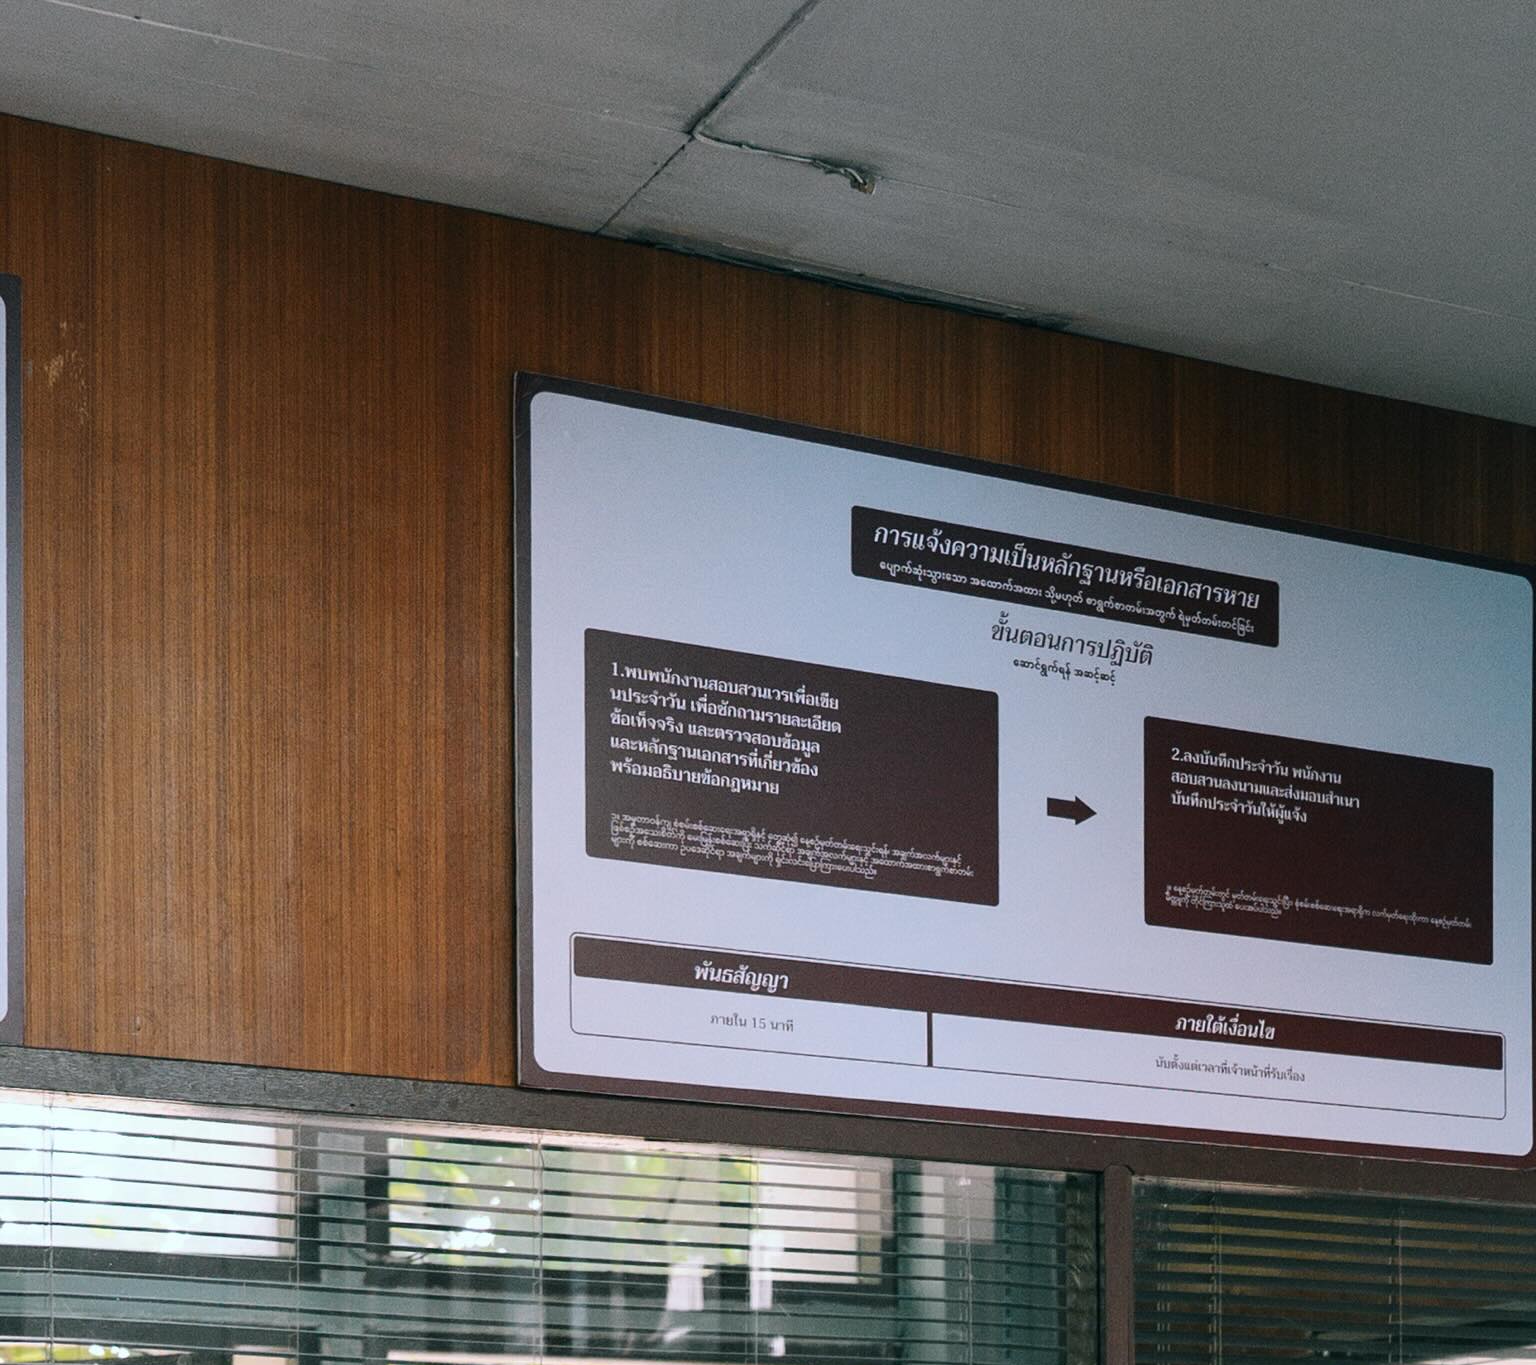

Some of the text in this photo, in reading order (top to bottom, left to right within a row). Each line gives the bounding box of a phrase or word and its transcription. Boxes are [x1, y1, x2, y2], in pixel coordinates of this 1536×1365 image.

[873, 525, 1260, 610] การแจ้งความเป็นหลักฐานหรือเอกสารหาย
[970, 577, 1042, 597] အထောက်အထား
[1044, 585, 1084, 607] သို့မဟုတ်
[991, 610, 1154, 667] ขั้นตอนการปฏิบัติ
[610, 661, 839, 710] 1.พบพนักงานสอบสวนเวรเพื่อเขีย
[610, 687, 842, 734] นประจำวัน เพื่อซักถามรายละเอียด
[610, 710, 821, 758] ข้อเท็จจริง และตรวจสอบข้อมูล
[610, 735, 818, 777] และหลักฐานเอกสารที่เกี่ยวข้อง
[1171, 747, 1342, 785] 2.ลงบันทึกประจำวัน พนักงาน
[610, 757, 780, 795] พร้อมอธิบายข้อกฎหมาย
[1171, 770, 1360, 808] สอบสวนลงนามและส่งมอบสำเนา
[1171, 790, 1308, 825] บันทึกประจำวันให้ผู้แจ้ง
[694, 960, 790, 993] พันธสัญญา
[710, 1012, 794, 1032] ภายใน 15 นาที
[1175, 1013, 1276, 1040] ภายใต้เงื่อนไข
[1155, 1053, 1306, 1082] นับตั้งแต่เวลาที่เจ้าหน้าที่รับเรื่อง
